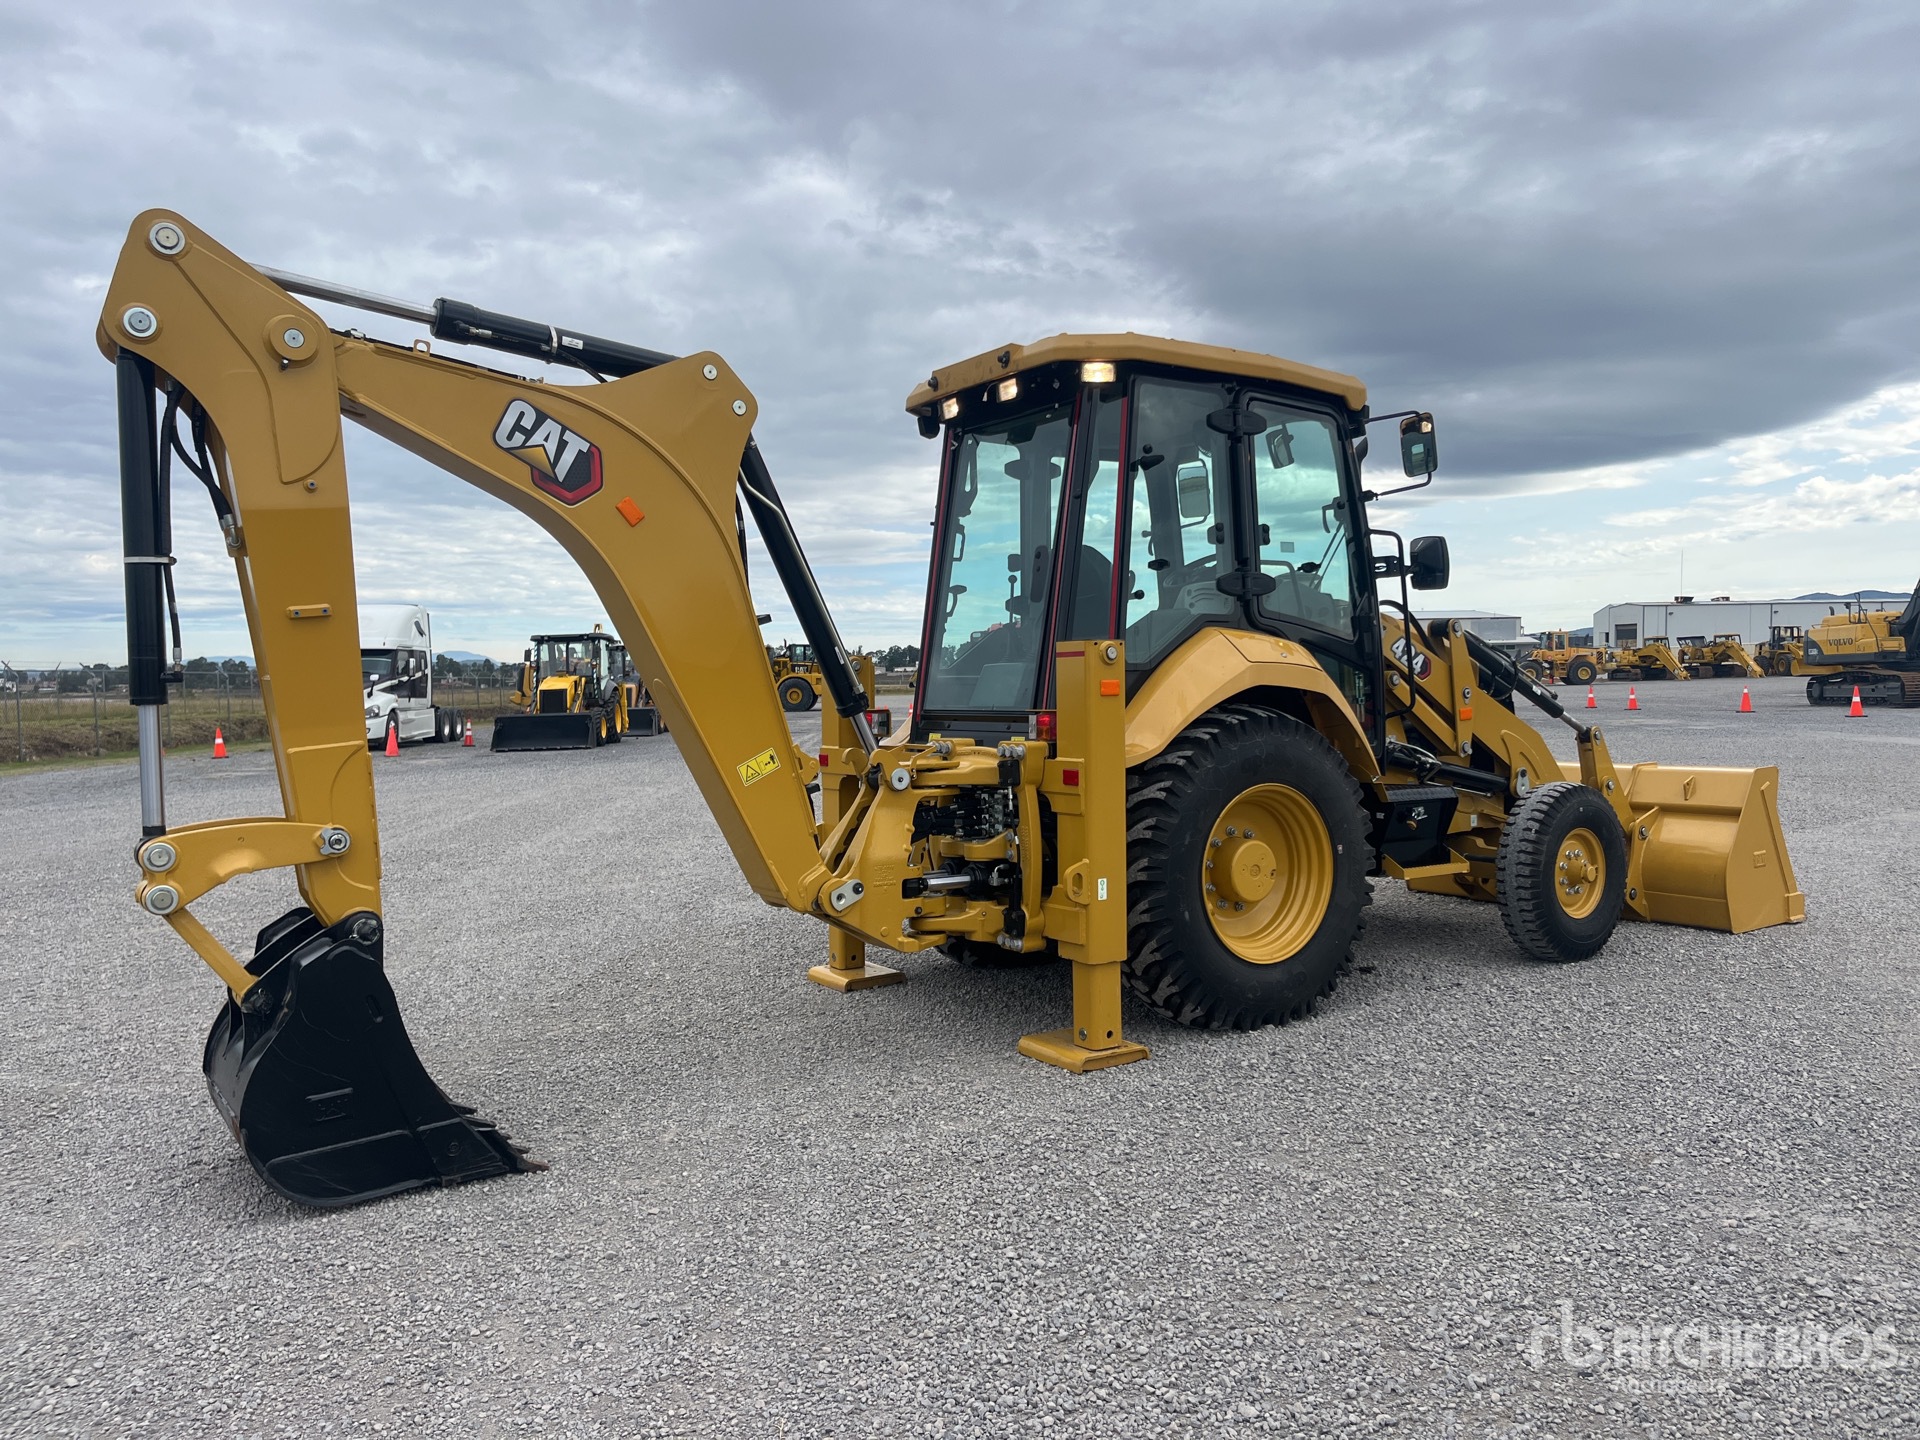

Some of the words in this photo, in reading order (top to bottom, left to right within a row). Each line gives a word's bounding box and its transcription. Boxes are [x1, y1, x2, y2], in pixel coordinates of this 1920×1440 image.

[495, 399, 591, 483] CAT
[1828, 637, 1854, 647] VOLVO
[794, 665, 808, 674] CAT
